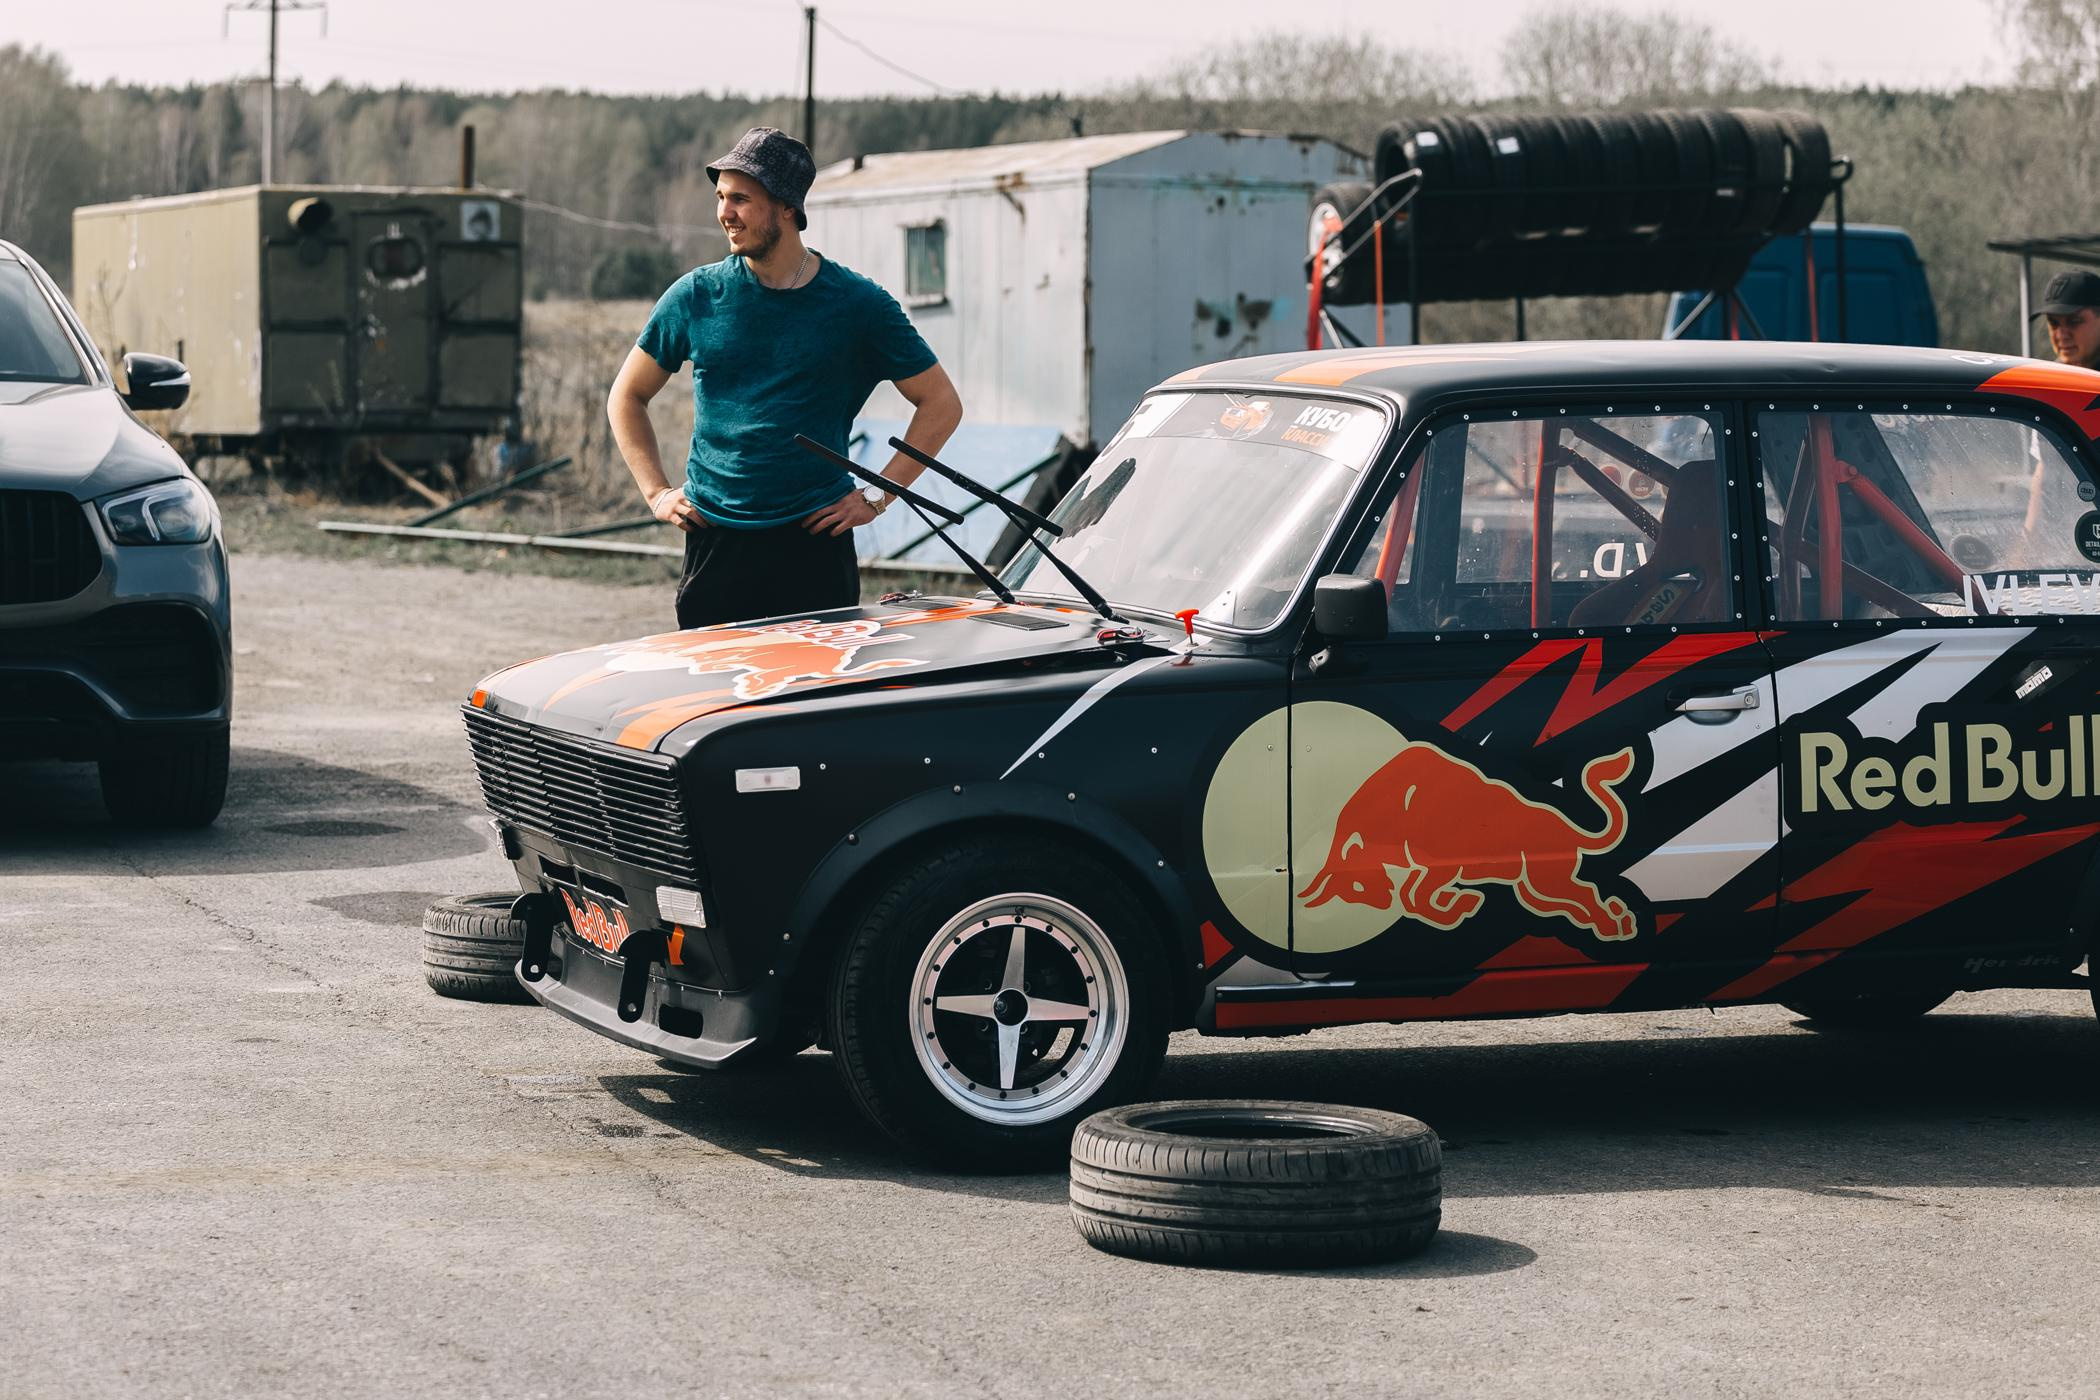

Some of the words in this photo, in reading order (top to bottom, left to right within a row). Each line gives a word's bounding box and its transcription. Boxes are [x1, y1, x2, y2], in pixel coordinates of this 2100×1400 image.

[1800, 721, 1951, 813] Red
[1965, 714, 2100, 804] Bull
[559, 887, 603, 949] Red
